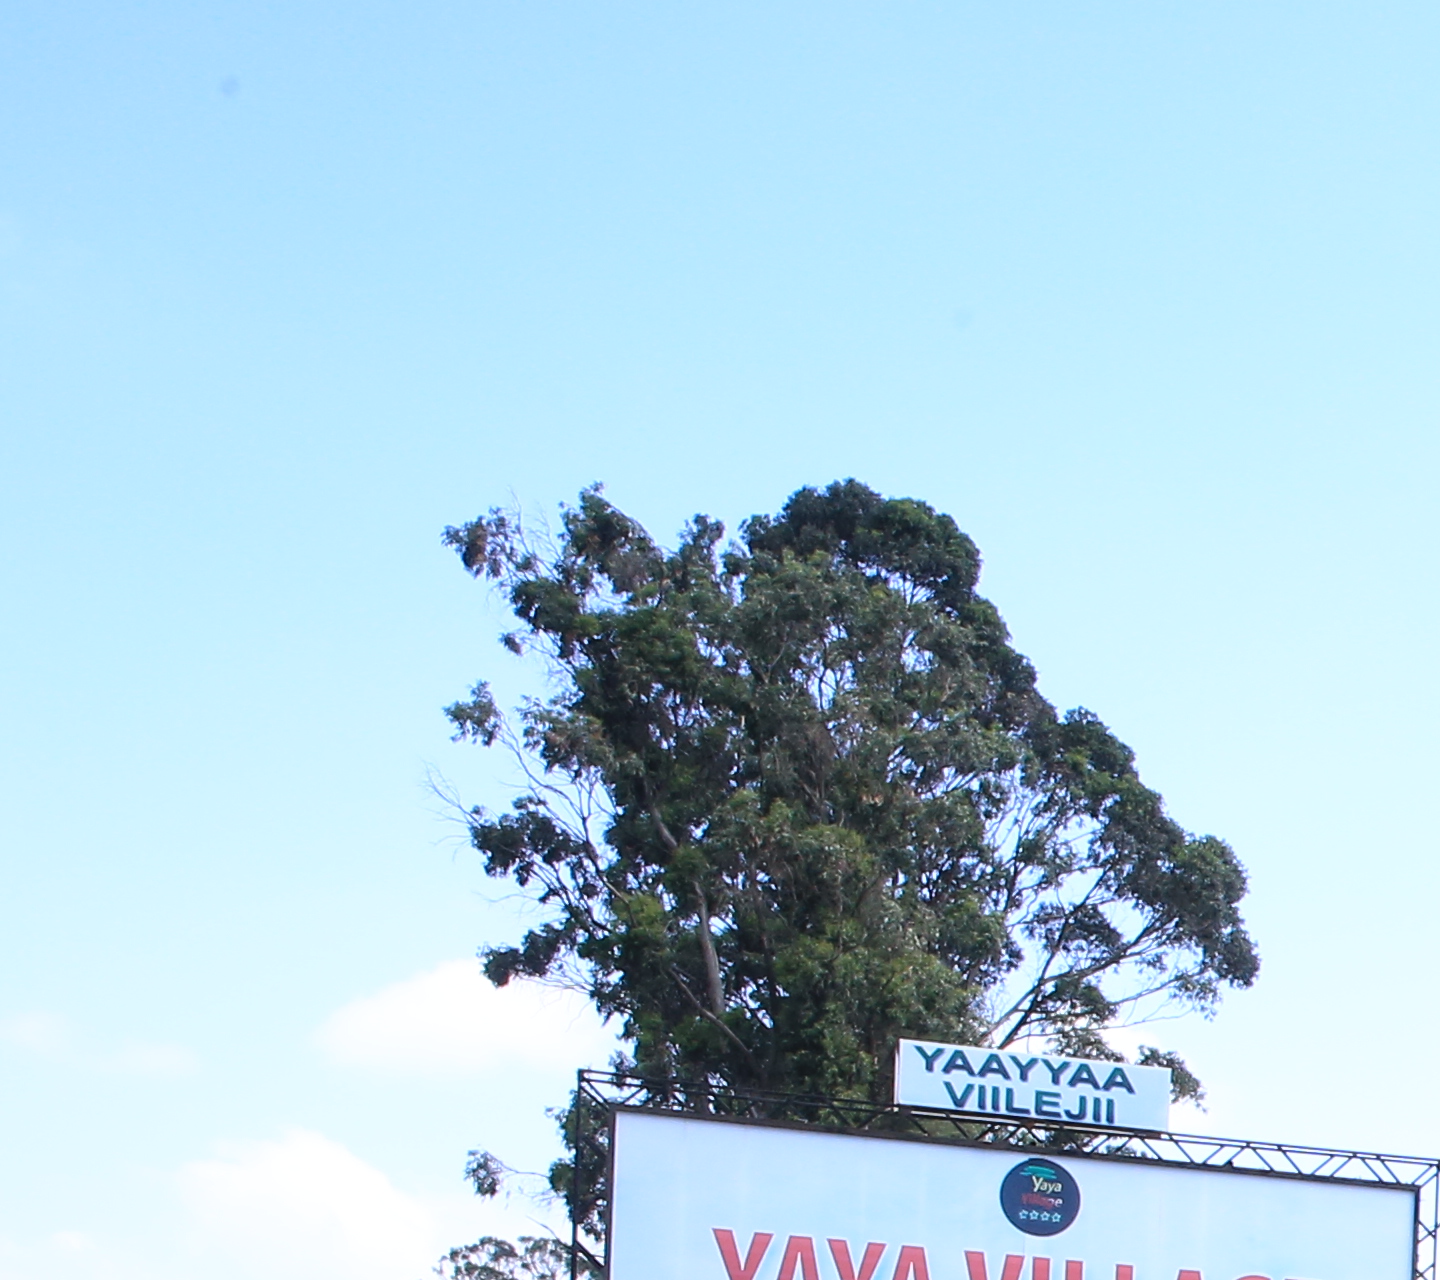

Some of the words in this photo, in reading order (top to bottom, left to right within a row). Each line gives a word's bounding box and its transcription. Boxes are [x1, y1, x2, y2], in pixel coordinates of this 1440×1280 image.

[914, 1045, 1136, 1095] YAAYYAA
[943, 1081, 1115, 1124] VIILEJII
[1032, 1175, 1062, 1194] Yaya
